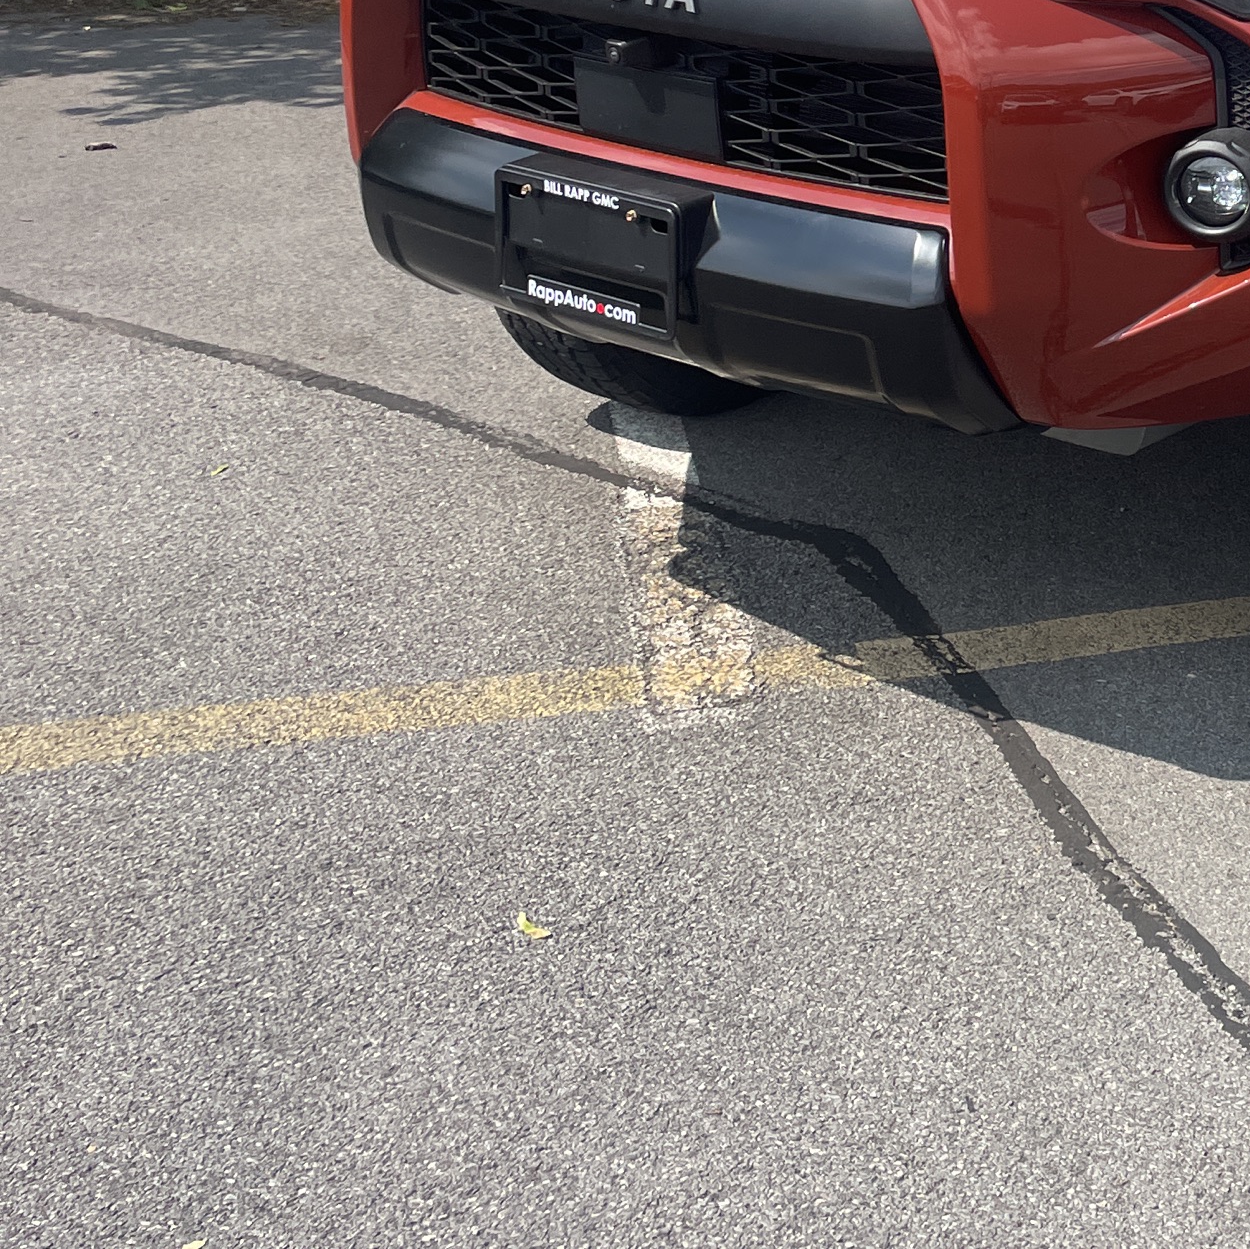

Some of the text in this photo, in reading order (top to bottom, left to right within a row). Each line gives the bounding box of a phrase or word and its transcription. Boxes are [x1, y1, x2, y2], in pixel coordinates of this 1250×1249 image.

[544, 180, 619, 209] BILL RAPP GMC
